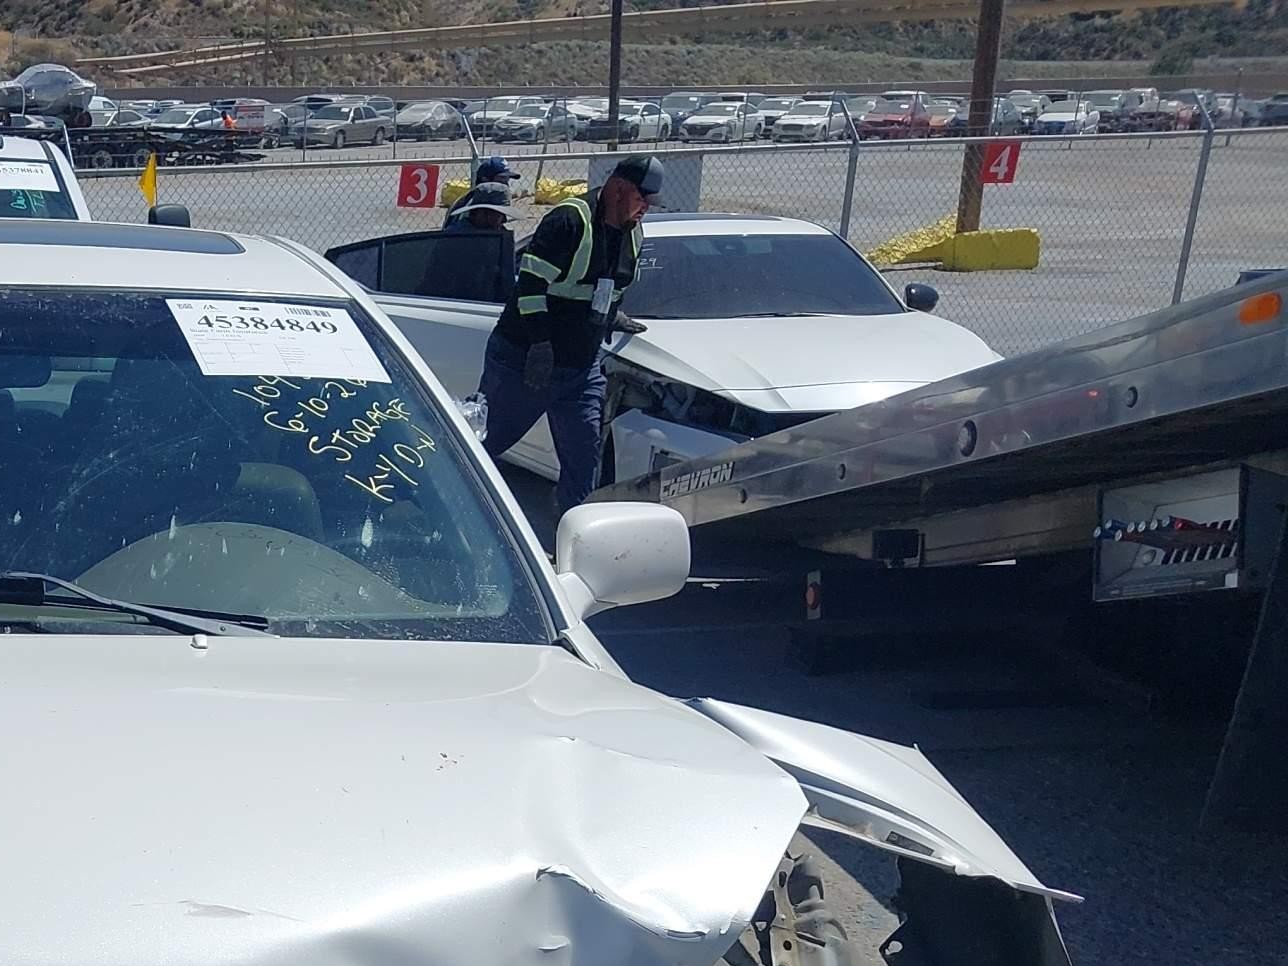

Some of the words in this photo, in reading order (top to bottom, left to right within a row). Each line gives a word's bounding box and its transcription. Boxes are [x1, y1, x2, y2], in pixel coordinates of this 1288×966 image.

[989, 145, 1011, 180] 4
[406, 168, 430, 204] 3
[197, 314, 338, 334] 45384849
[661, 461, 735, 497] CHEVRON
